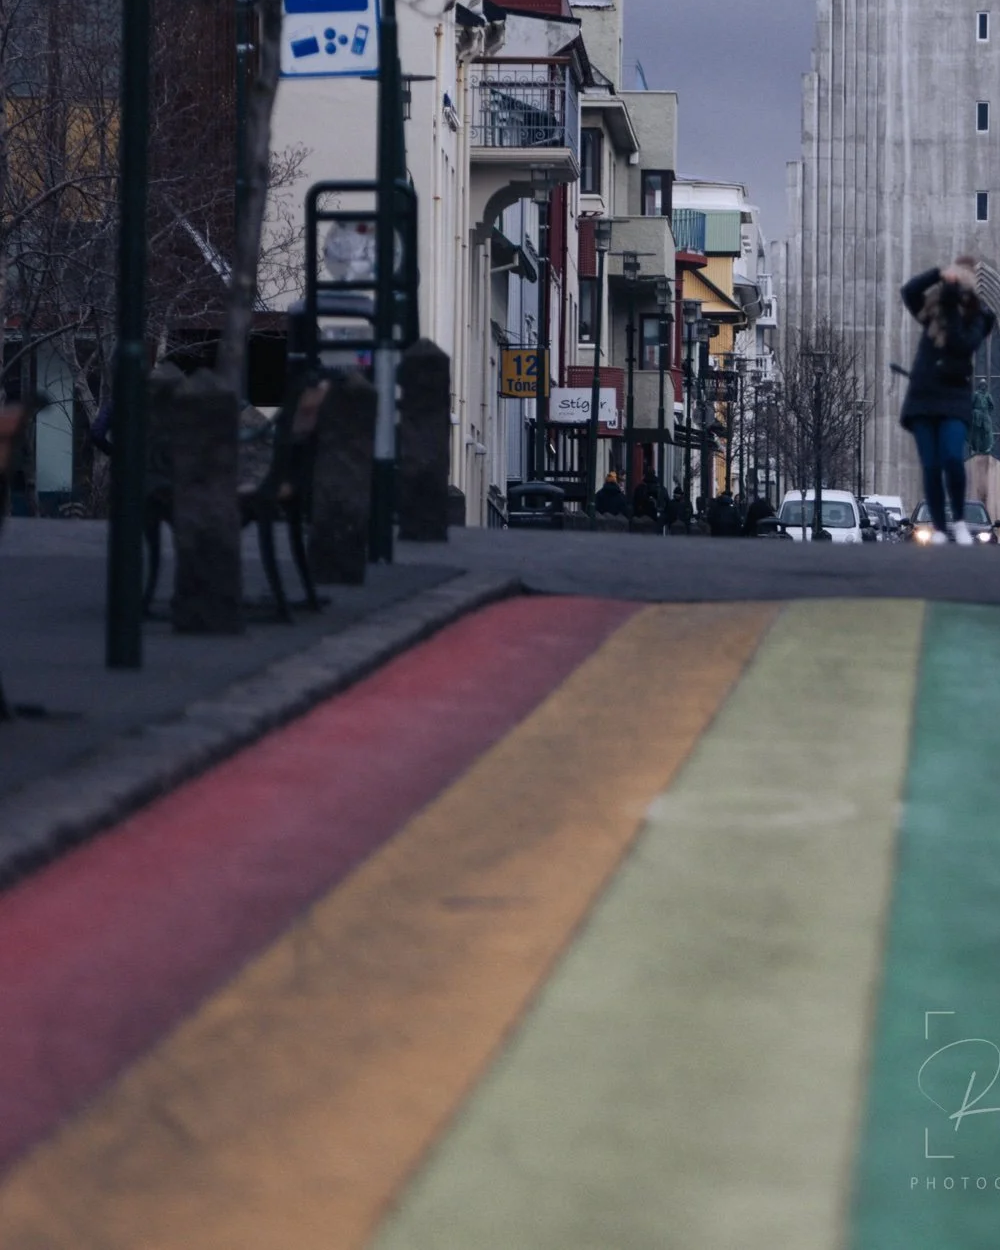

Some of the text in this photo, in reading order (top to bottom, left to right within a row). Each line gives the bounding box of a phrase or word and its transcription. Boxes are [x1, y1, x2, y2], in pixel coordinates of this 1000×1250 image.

[513, 355, 539, 376] 12
[507, 377, 537, 392] Tóna
[558, 397, 606, 413] Stígr
